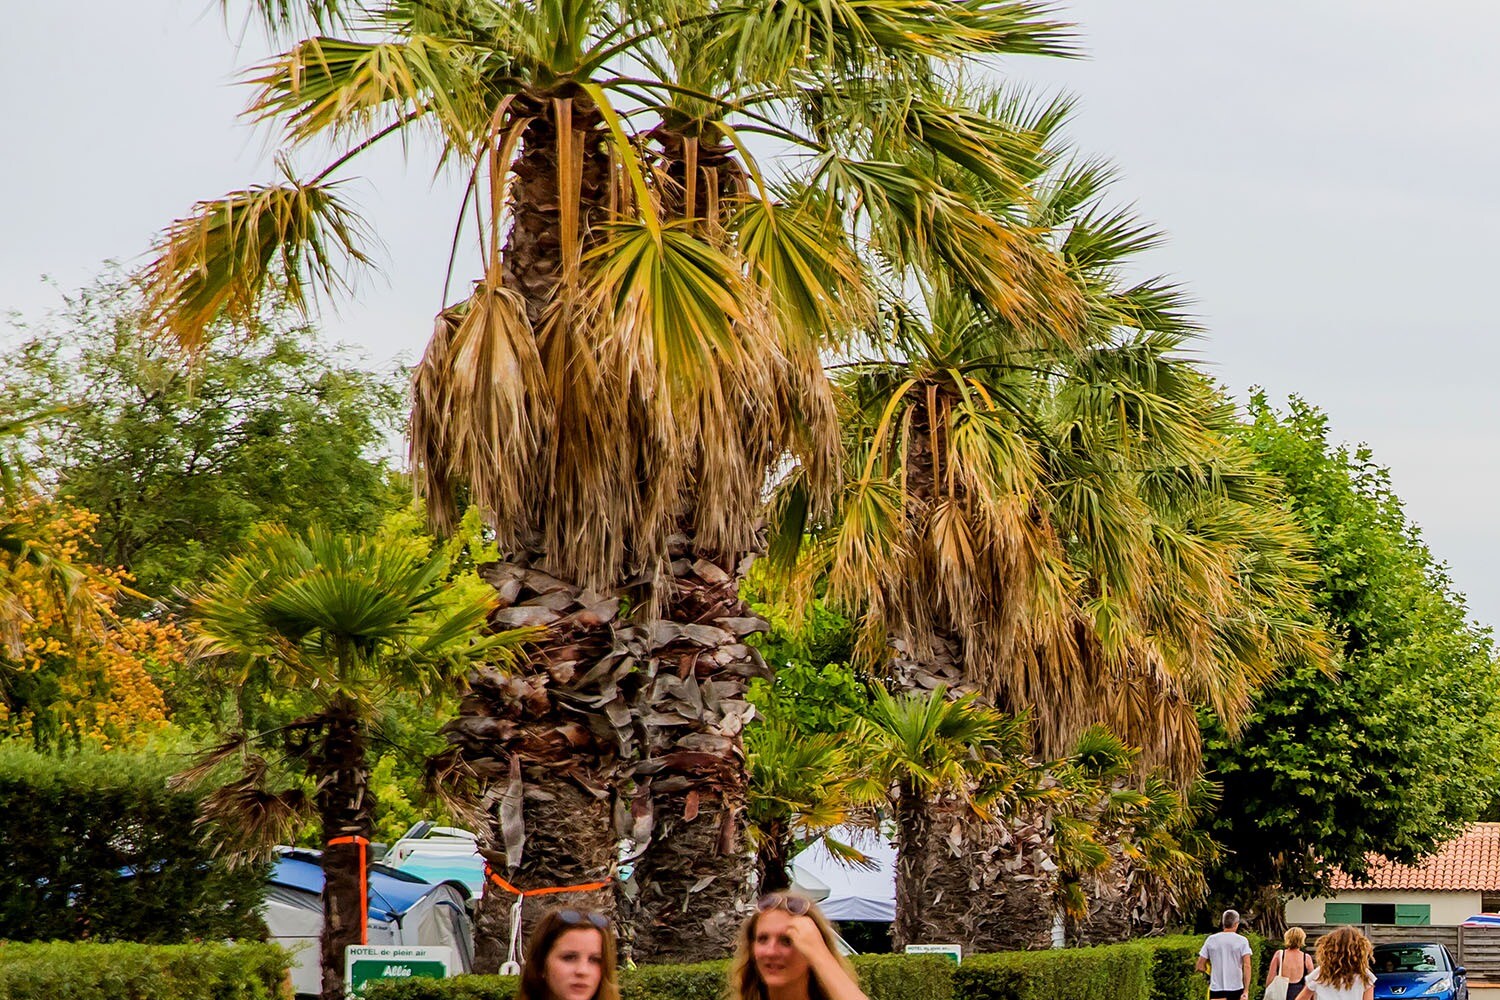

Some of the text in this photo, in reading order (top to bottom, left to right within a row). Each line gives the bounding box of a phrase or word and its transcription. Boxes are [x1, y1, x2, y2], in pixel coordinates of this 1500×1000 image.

[350, 948, 378, 956] HOTEL
[393, 948, 413, 957] plein
[382, 964, 412, 977] Allée
